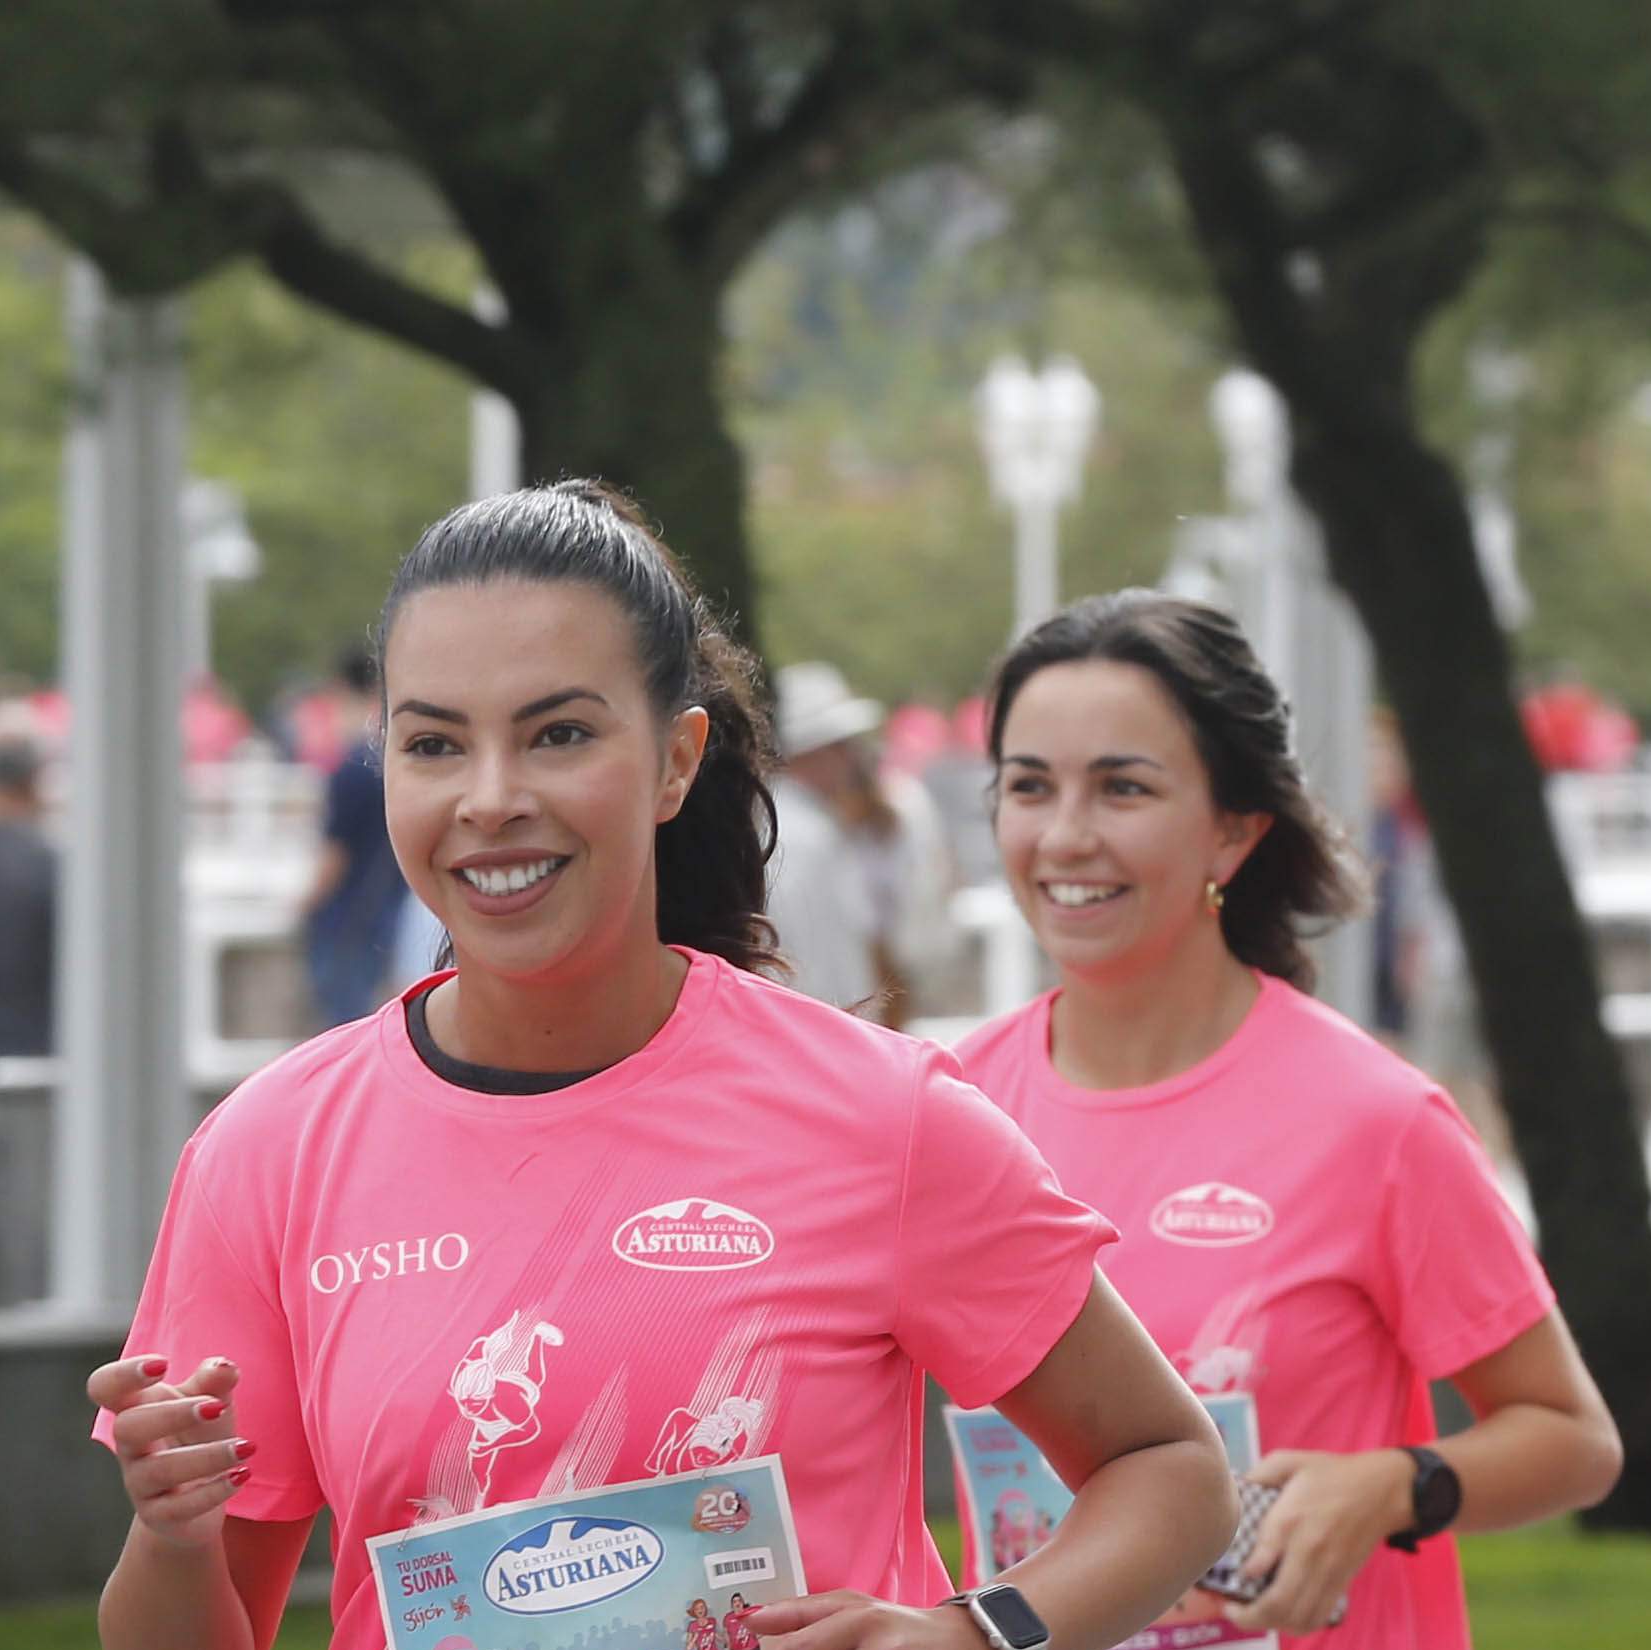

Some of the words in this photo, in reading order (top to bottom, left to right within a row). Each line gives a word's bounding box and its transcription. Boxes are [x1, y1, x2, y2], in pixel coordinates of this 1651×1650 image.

[626, 1226, 762, 1254] ASTURIANA
[310, 1232, 469, 1294] OYSHO
[397, 1561, 411, 1574] TU
[413, 1552, 453, 1570] DORSAL
[513, 1547, 575, 1570] CENTRAL
[578, 1532, 639, 1554] LECHERA
[401, 1567, 458, 1596] SUMA
[498, 1544, 652, 1601] ASTURIANA
